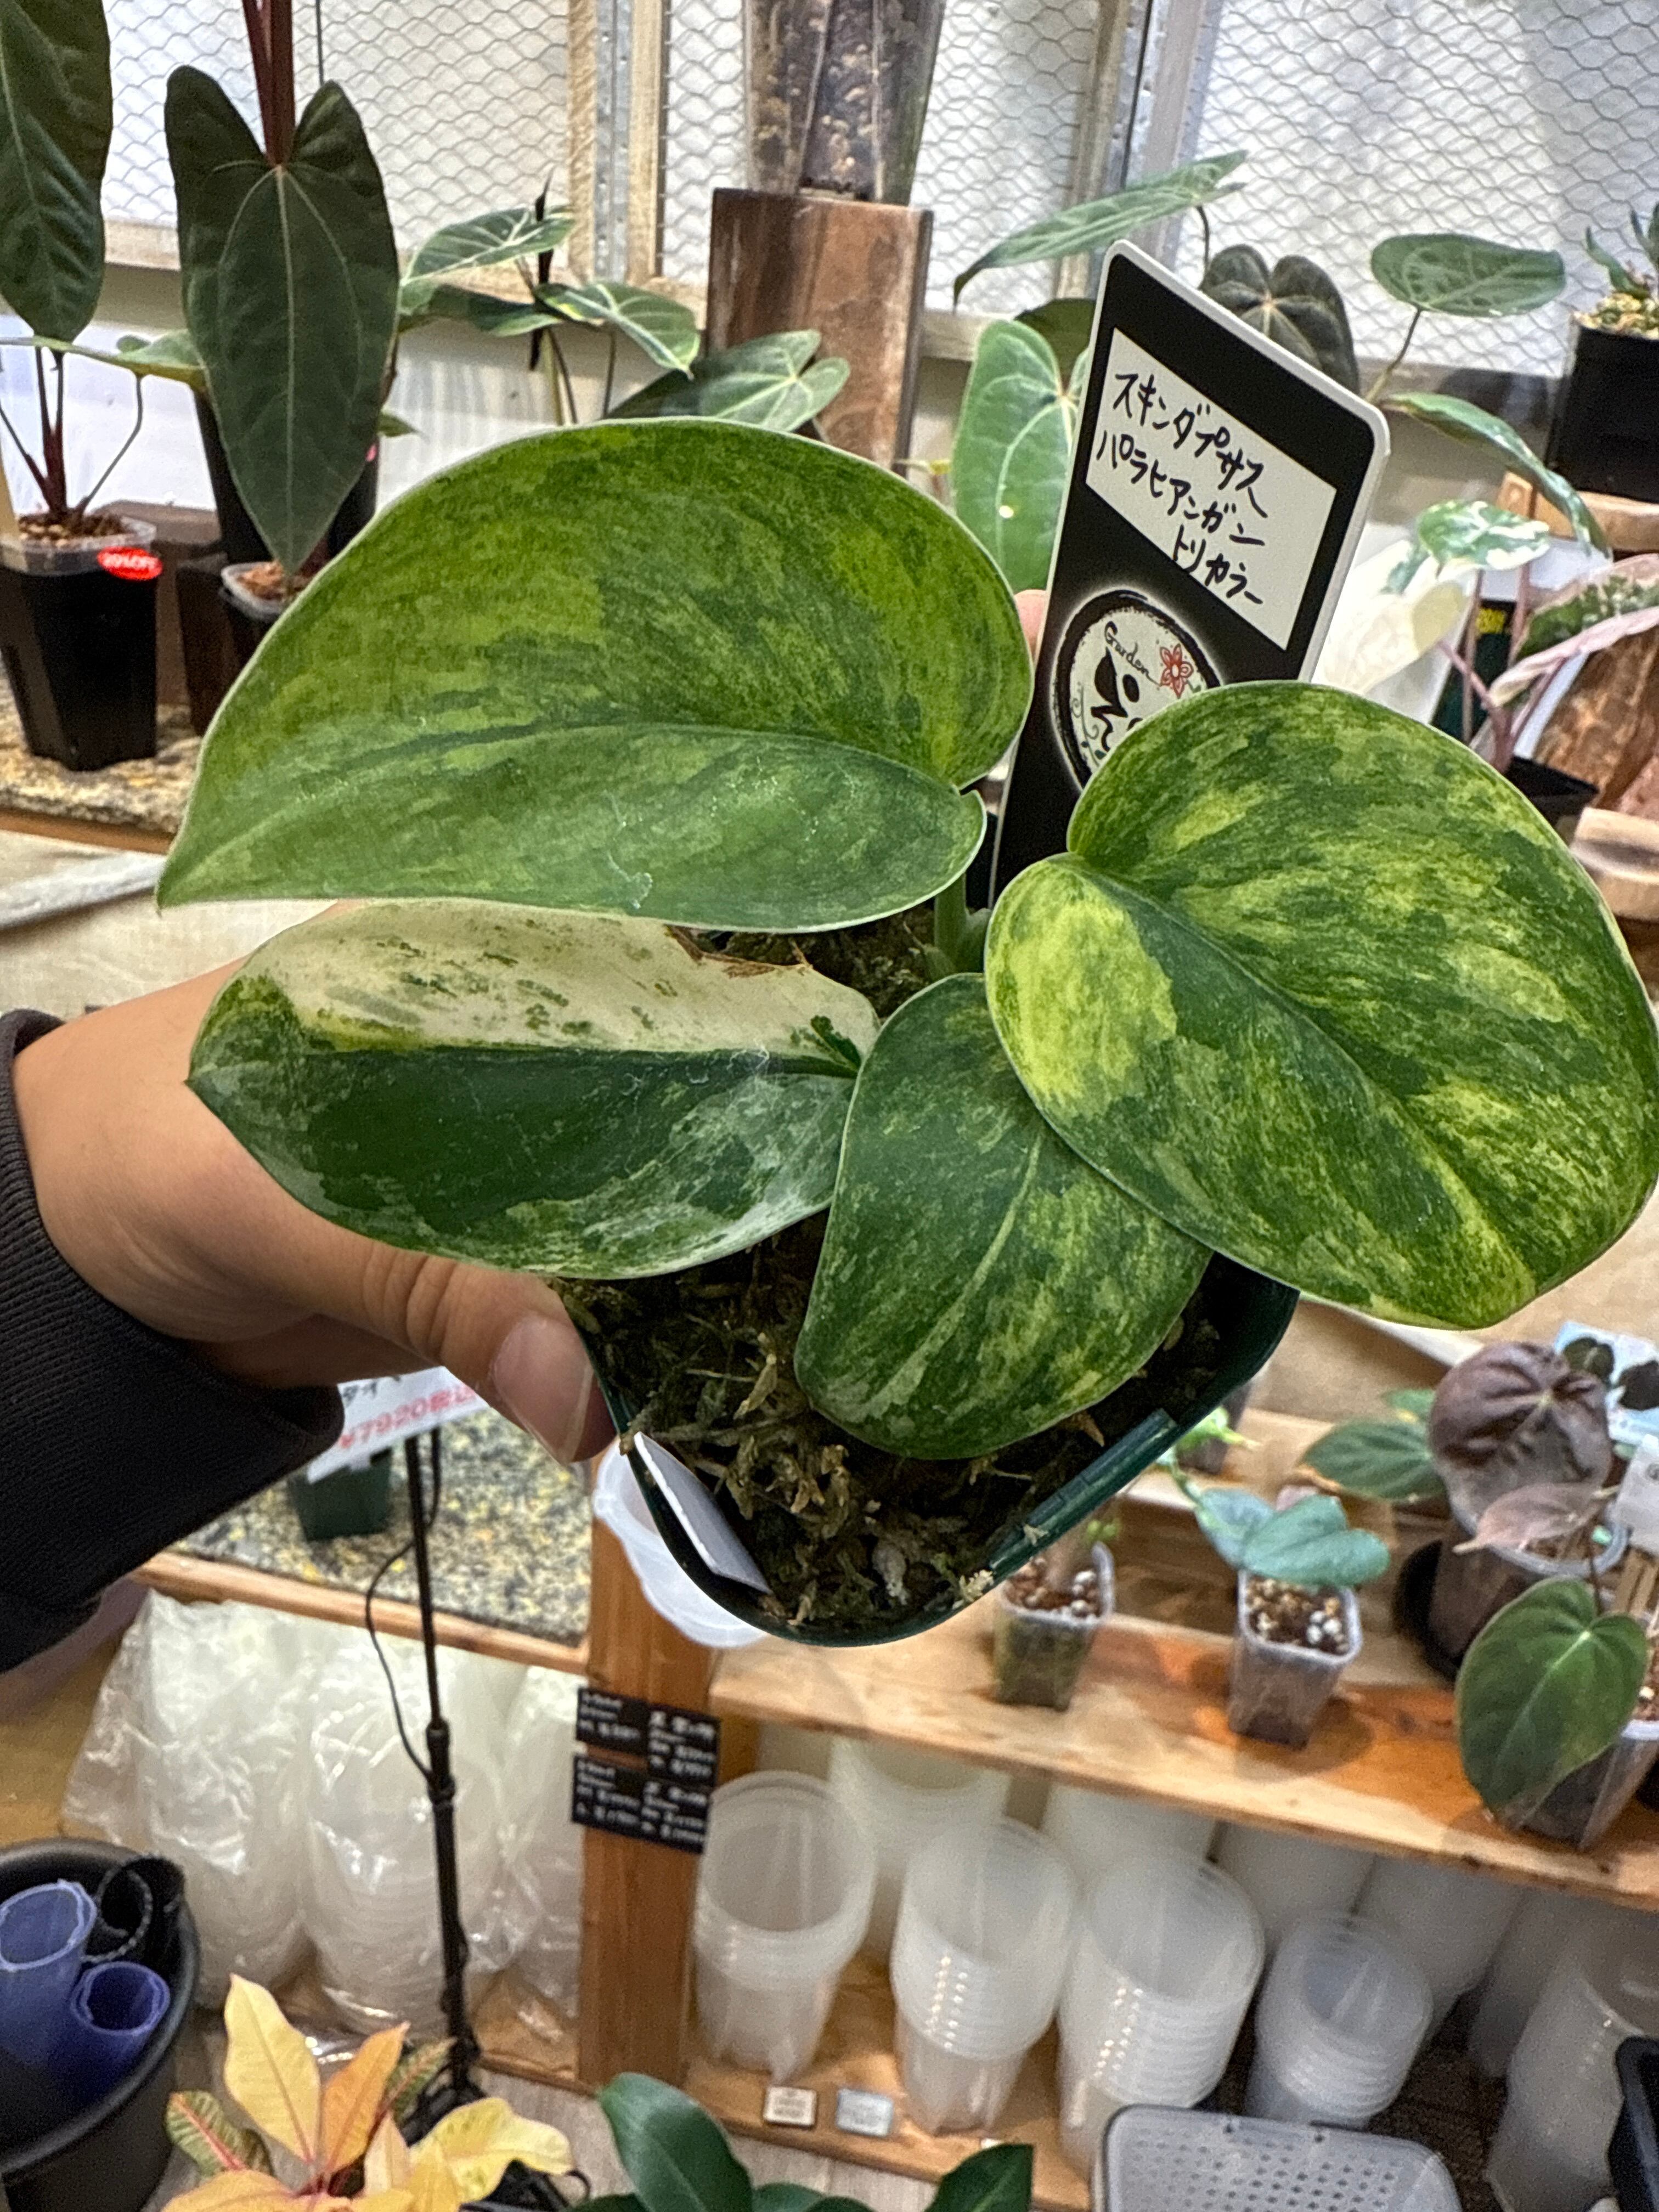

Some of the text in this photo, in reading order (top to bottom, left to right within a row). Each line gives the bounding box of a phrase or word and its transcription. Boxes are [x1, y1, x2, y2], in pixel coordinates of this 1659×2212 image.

[1113, 374, 1268, 518] スキンダプサス
[1173, 524, 1263, 605] トリカラー
[1104, 620, 1158, 684] Garden
